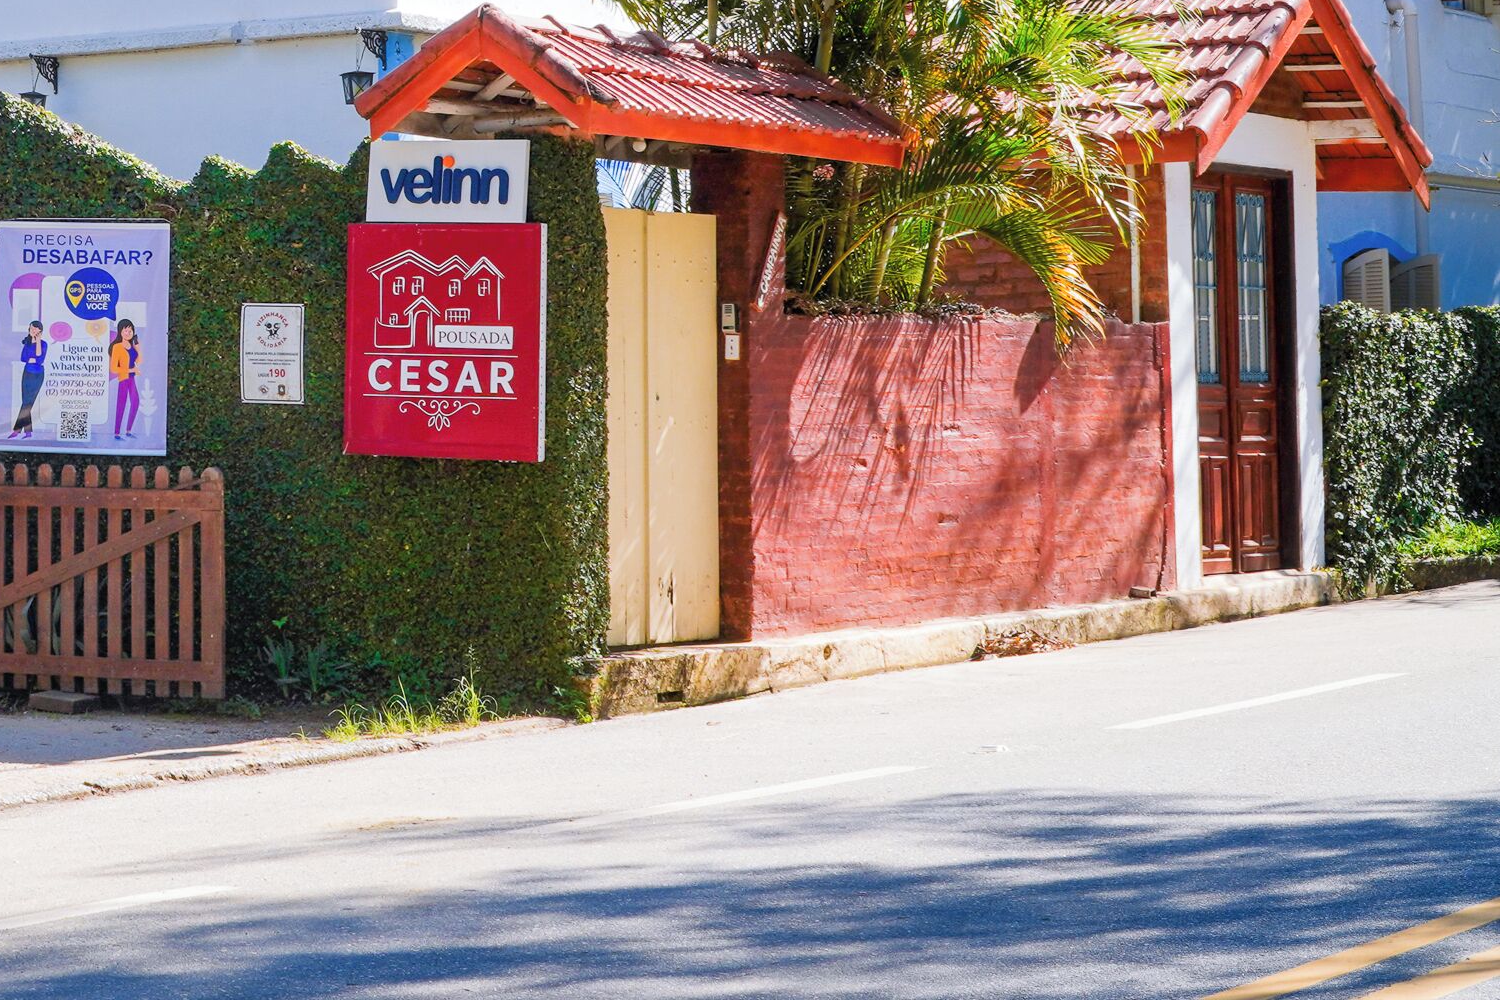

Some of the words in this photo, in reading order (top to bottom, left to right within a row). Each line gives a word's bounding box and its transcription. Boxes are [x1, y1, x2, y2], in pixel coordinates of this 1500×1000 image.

[380, 155, 510, 204] velinn
[24, 234, 94, 246] PRECISA
[22, 248, 153, 266] DESABAFAR?
[760, 216, 787, 294] CAMPAINHA
[86, 302, 108, 310] VOCÊ
[438, 330, 511, 345] POUSADA
[62, 344, 88, 354] Ligue
[60, 354, 85, 362] envie
[51, 362, 103, 373] WhatsApp:
[269, 369, 286, 378] 190
[368, 358, 515, 394] CESAR
